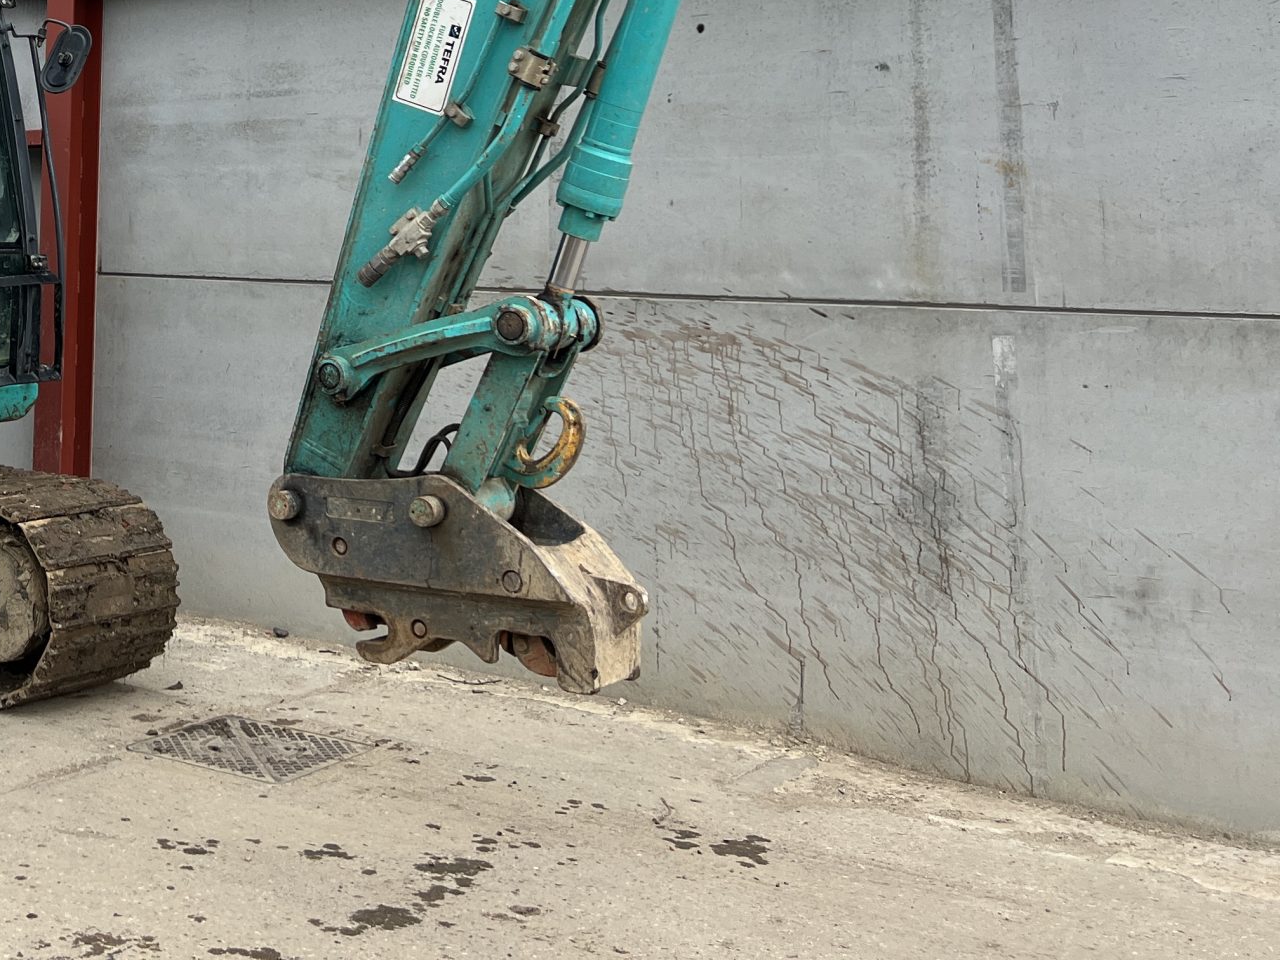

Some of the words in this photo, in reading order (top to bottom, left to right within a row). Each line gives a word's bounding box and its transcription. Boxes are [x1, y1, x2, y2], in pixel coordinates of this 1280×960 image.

[423, 6, 432, 17] NO
[416, 17, 429, 41] SAFETY
[423, 23, 437, 50] LOCKING
[436, 25, 446, 43] FULLY
[413, 41, 422, 53] PIN
[403, 53, 418, 85] REQUIRED
[416, 50, 429, 77] COUPLER
[425, 43, 441, 80] AUTOMATIC
[434, 41, 455, 84] TEFRA
[409, 77, 421, 99] FITTED
